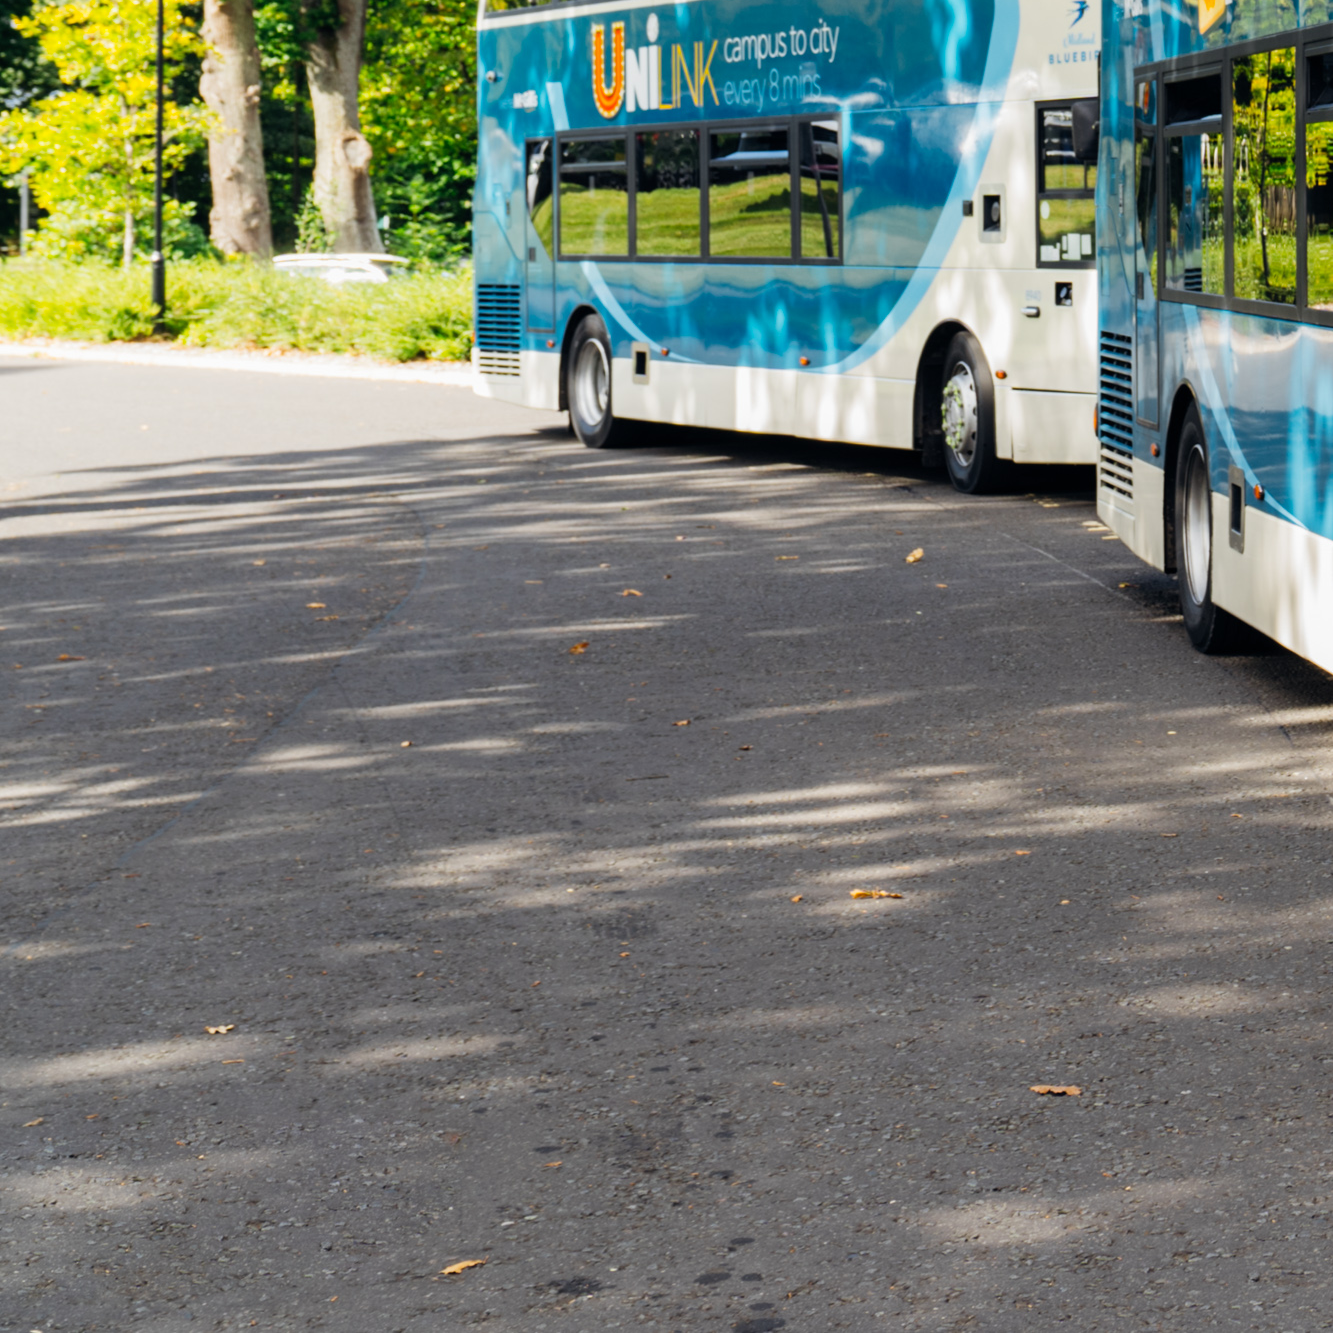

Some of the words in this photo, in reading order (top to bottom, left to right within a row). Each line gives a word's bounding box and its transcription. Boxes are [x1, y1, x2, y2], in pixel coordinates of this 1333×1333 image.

[724, 31, 787, 69] campus
[790, 26, 808, 56] to
[809, 18, 840, 63] city
[1048, 50, 1100, 65] BLUEBIR
[724, 76, 767, 113] every
[769, 68, 780, 102] 8
[782, 65, 821, 101] mins
